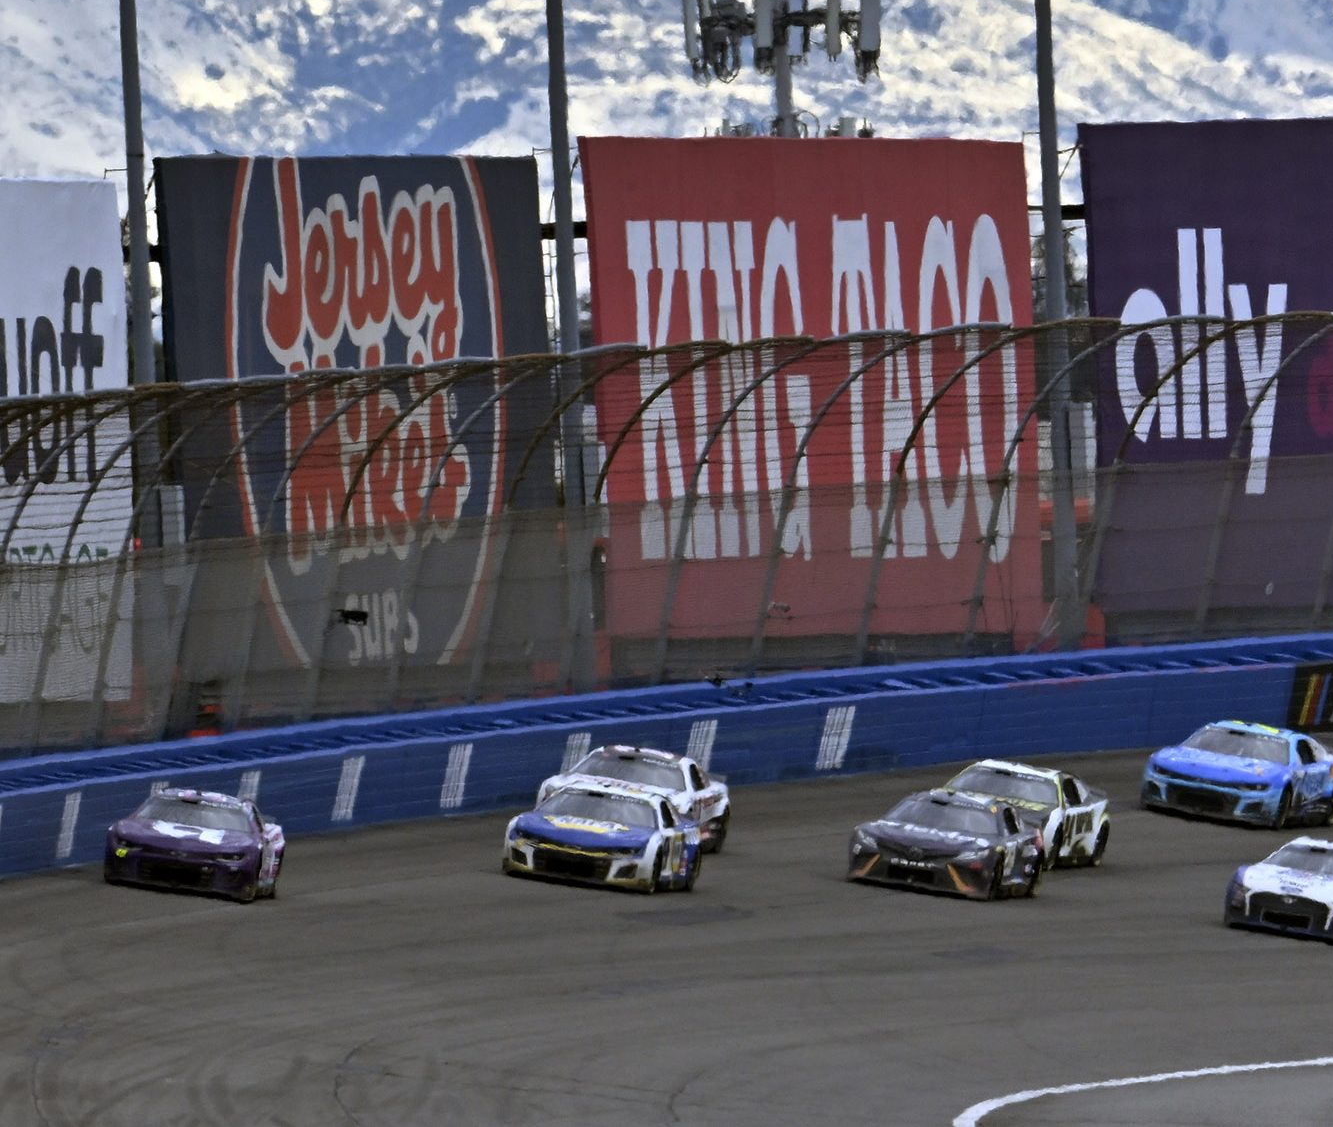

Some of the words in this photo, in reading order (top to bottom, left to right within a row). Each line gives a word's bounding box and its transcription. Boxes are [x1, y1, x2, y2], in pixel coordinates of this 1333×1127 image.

[262, 154, 464, 364] Jersey
[625, 216, 812, 561] KING
[831, 212, 1019, 564] TACO
[1115, 227, 1288, 495] ally
